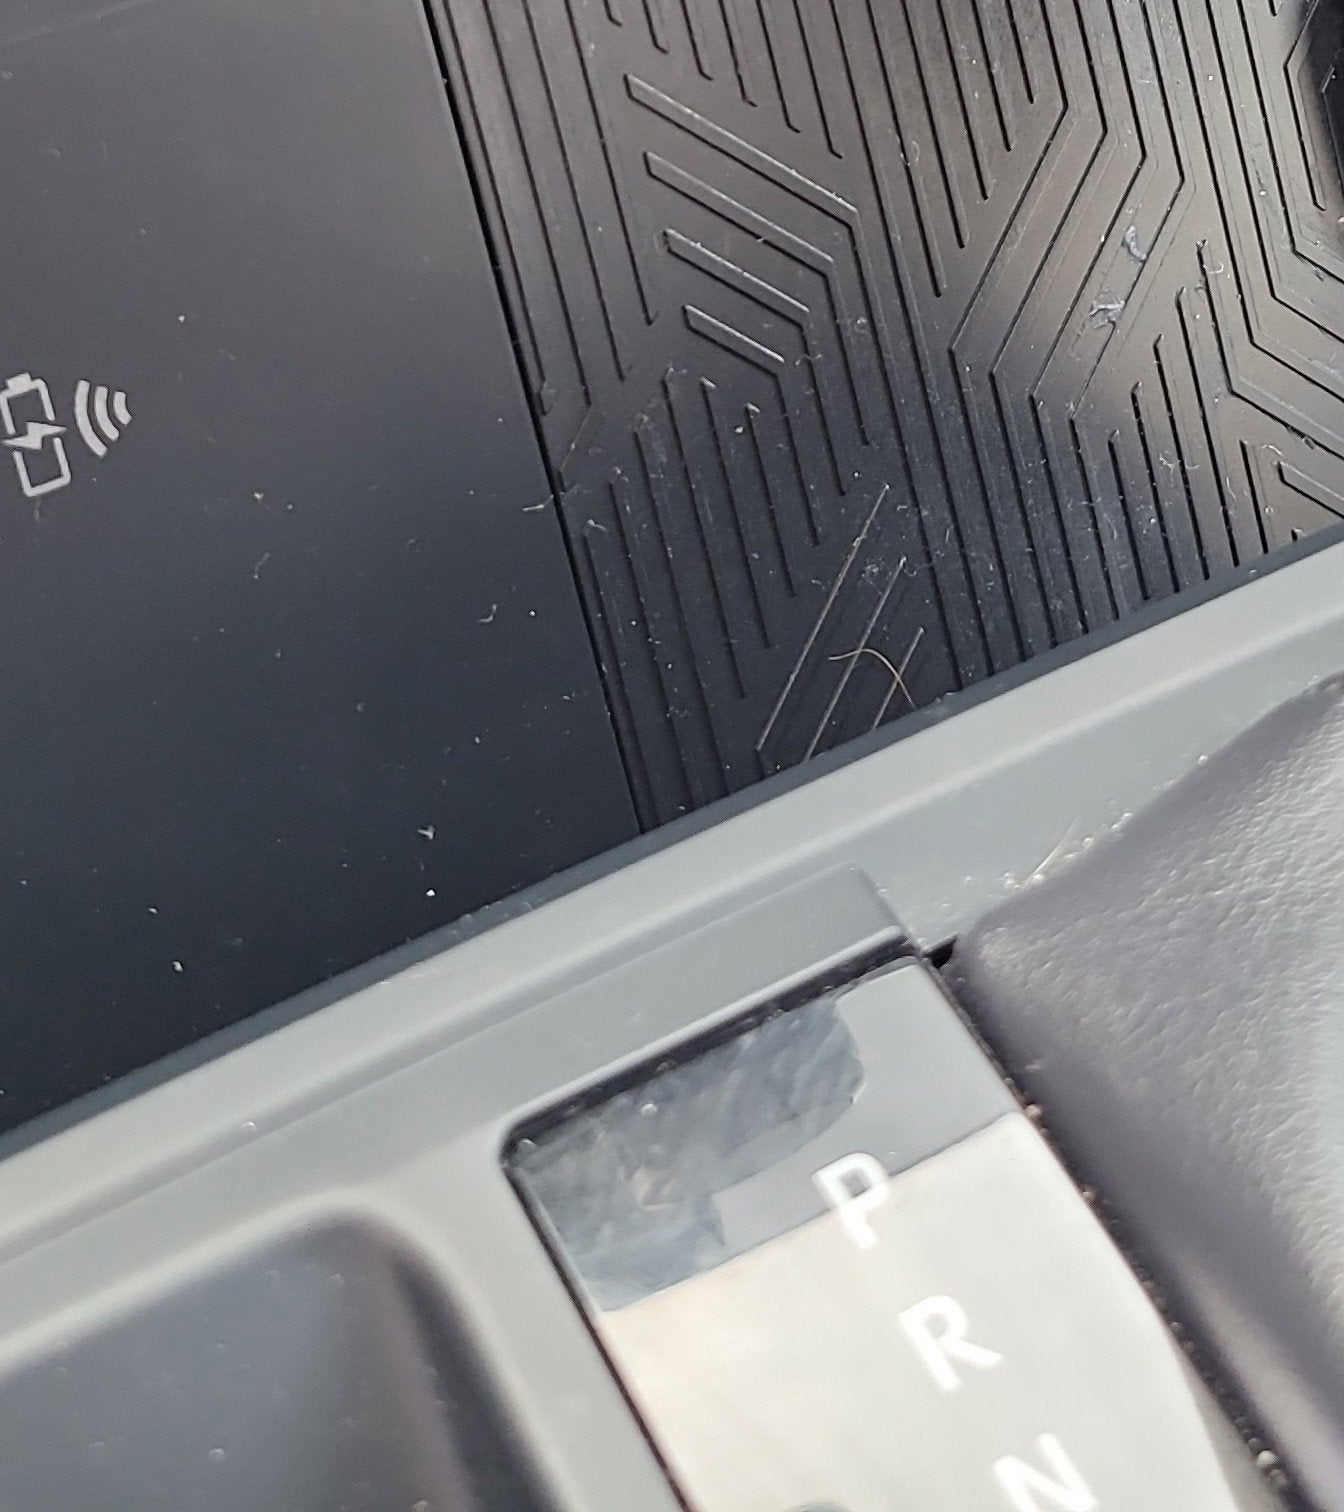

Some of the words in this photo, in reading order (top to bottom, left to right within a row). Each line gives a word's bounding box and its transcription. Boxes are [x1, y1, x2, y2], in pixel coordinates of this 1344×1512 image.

[812, 1152, 889, 1249] P
[898, 1294, 1005, 1389] R
[993, 1432, 1097, 1512] N
